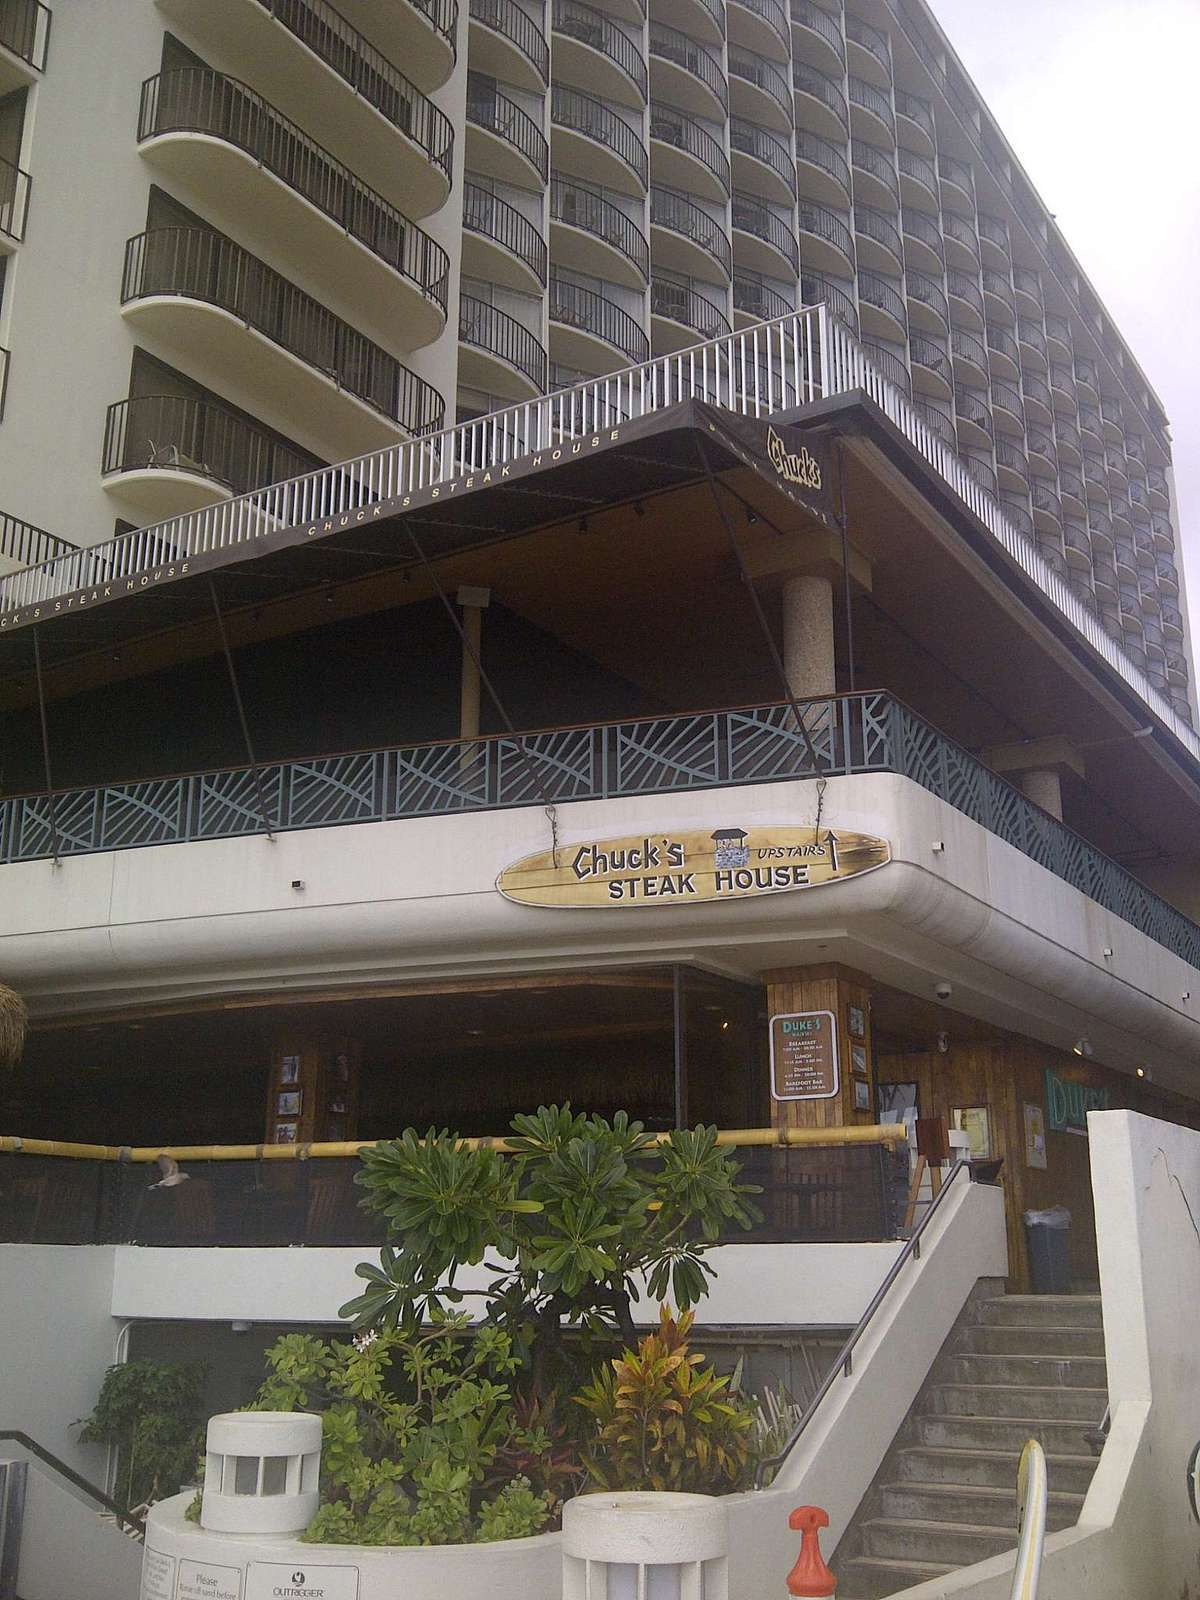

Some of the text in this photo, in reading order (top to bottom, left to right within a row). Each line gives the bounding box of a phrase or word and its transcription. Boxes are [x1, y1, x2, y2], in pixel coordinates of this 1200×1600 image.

[307, 430, 619, 536] CHUCK'S STEAK HOUSE
[55, 587, 111, 611] STEAK
[126, 563, 189, 590] HOUSE
[572, 838, 684, 880] Chuck's
[757, 845, 826, 860] UPSTAIRS
[608, 864, 810, 900] STEAK HOUSE
[272, 1587, 325, 1598] OUTRIGGER
